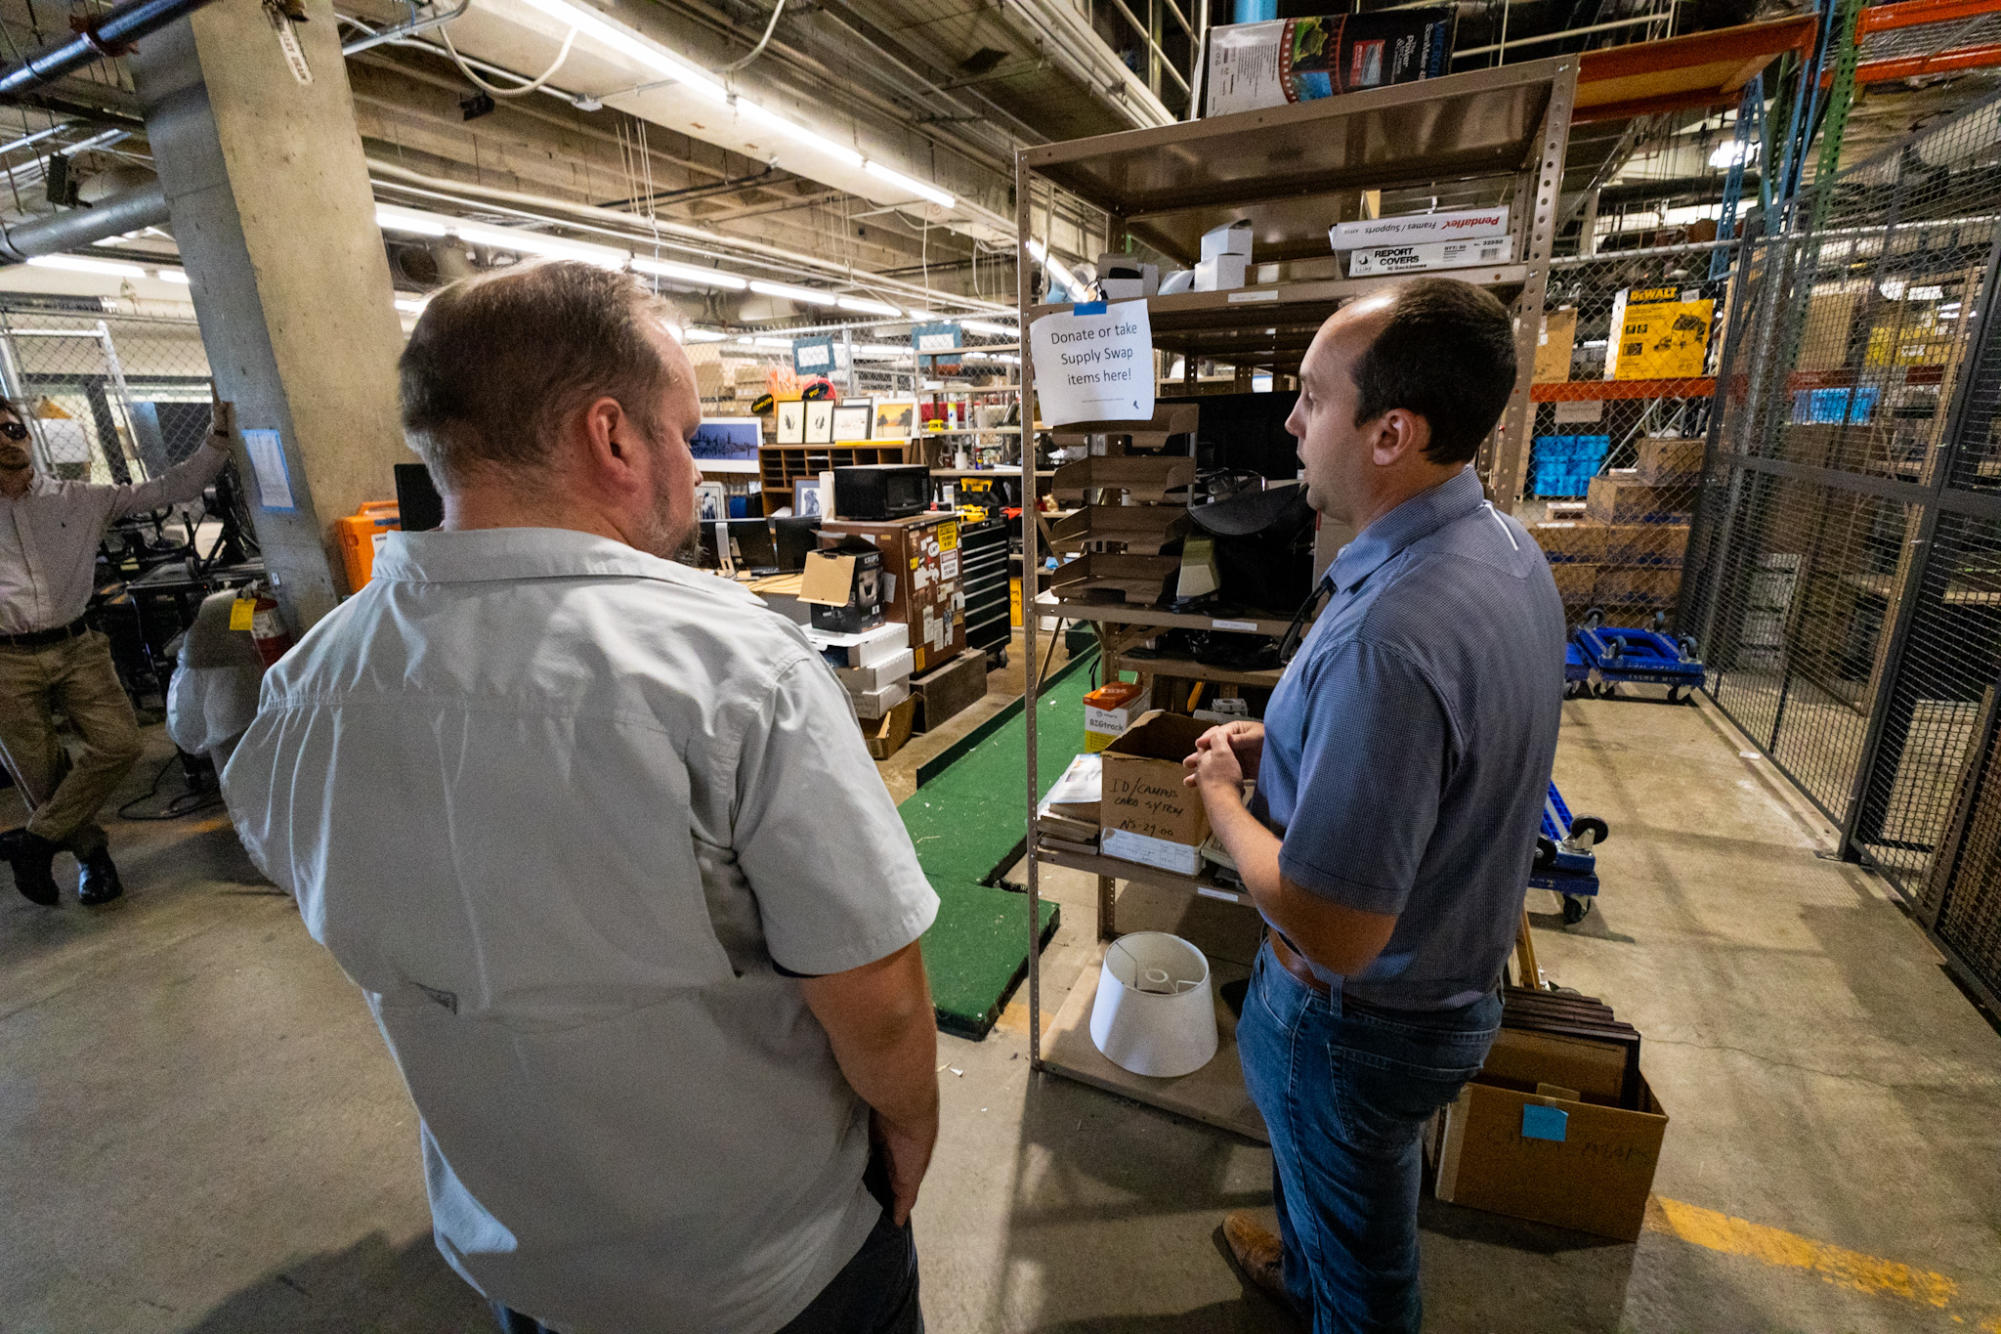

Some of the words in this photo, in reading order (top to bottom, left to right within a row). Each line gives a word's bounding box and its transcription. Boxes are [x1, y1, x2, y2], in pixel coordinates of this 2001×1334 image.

[1403, 35, 1415, 67] Power
[1420, 24, 1433, 70] ScanMaker
[1364, 224, 1401, 234] Supports
[1407, 221, 1438, 230] Frames
[1442, 215, 1500, 230] Pendaflex
[1374, 247, 1414, 258] REPORT
[1379, 255, 1420, 266] COVERS
[1051, 328, 1095, 345] Donate
[1098, 327, 1111, 338] or
[1115, 322, 1137, 336] take
[1061, 350, 1101, 366] Supply
[1104, 347, 1133, 360] Swap
[1067, 373, 1100, 386] items
[1103, 367, 1132, 381] here!
